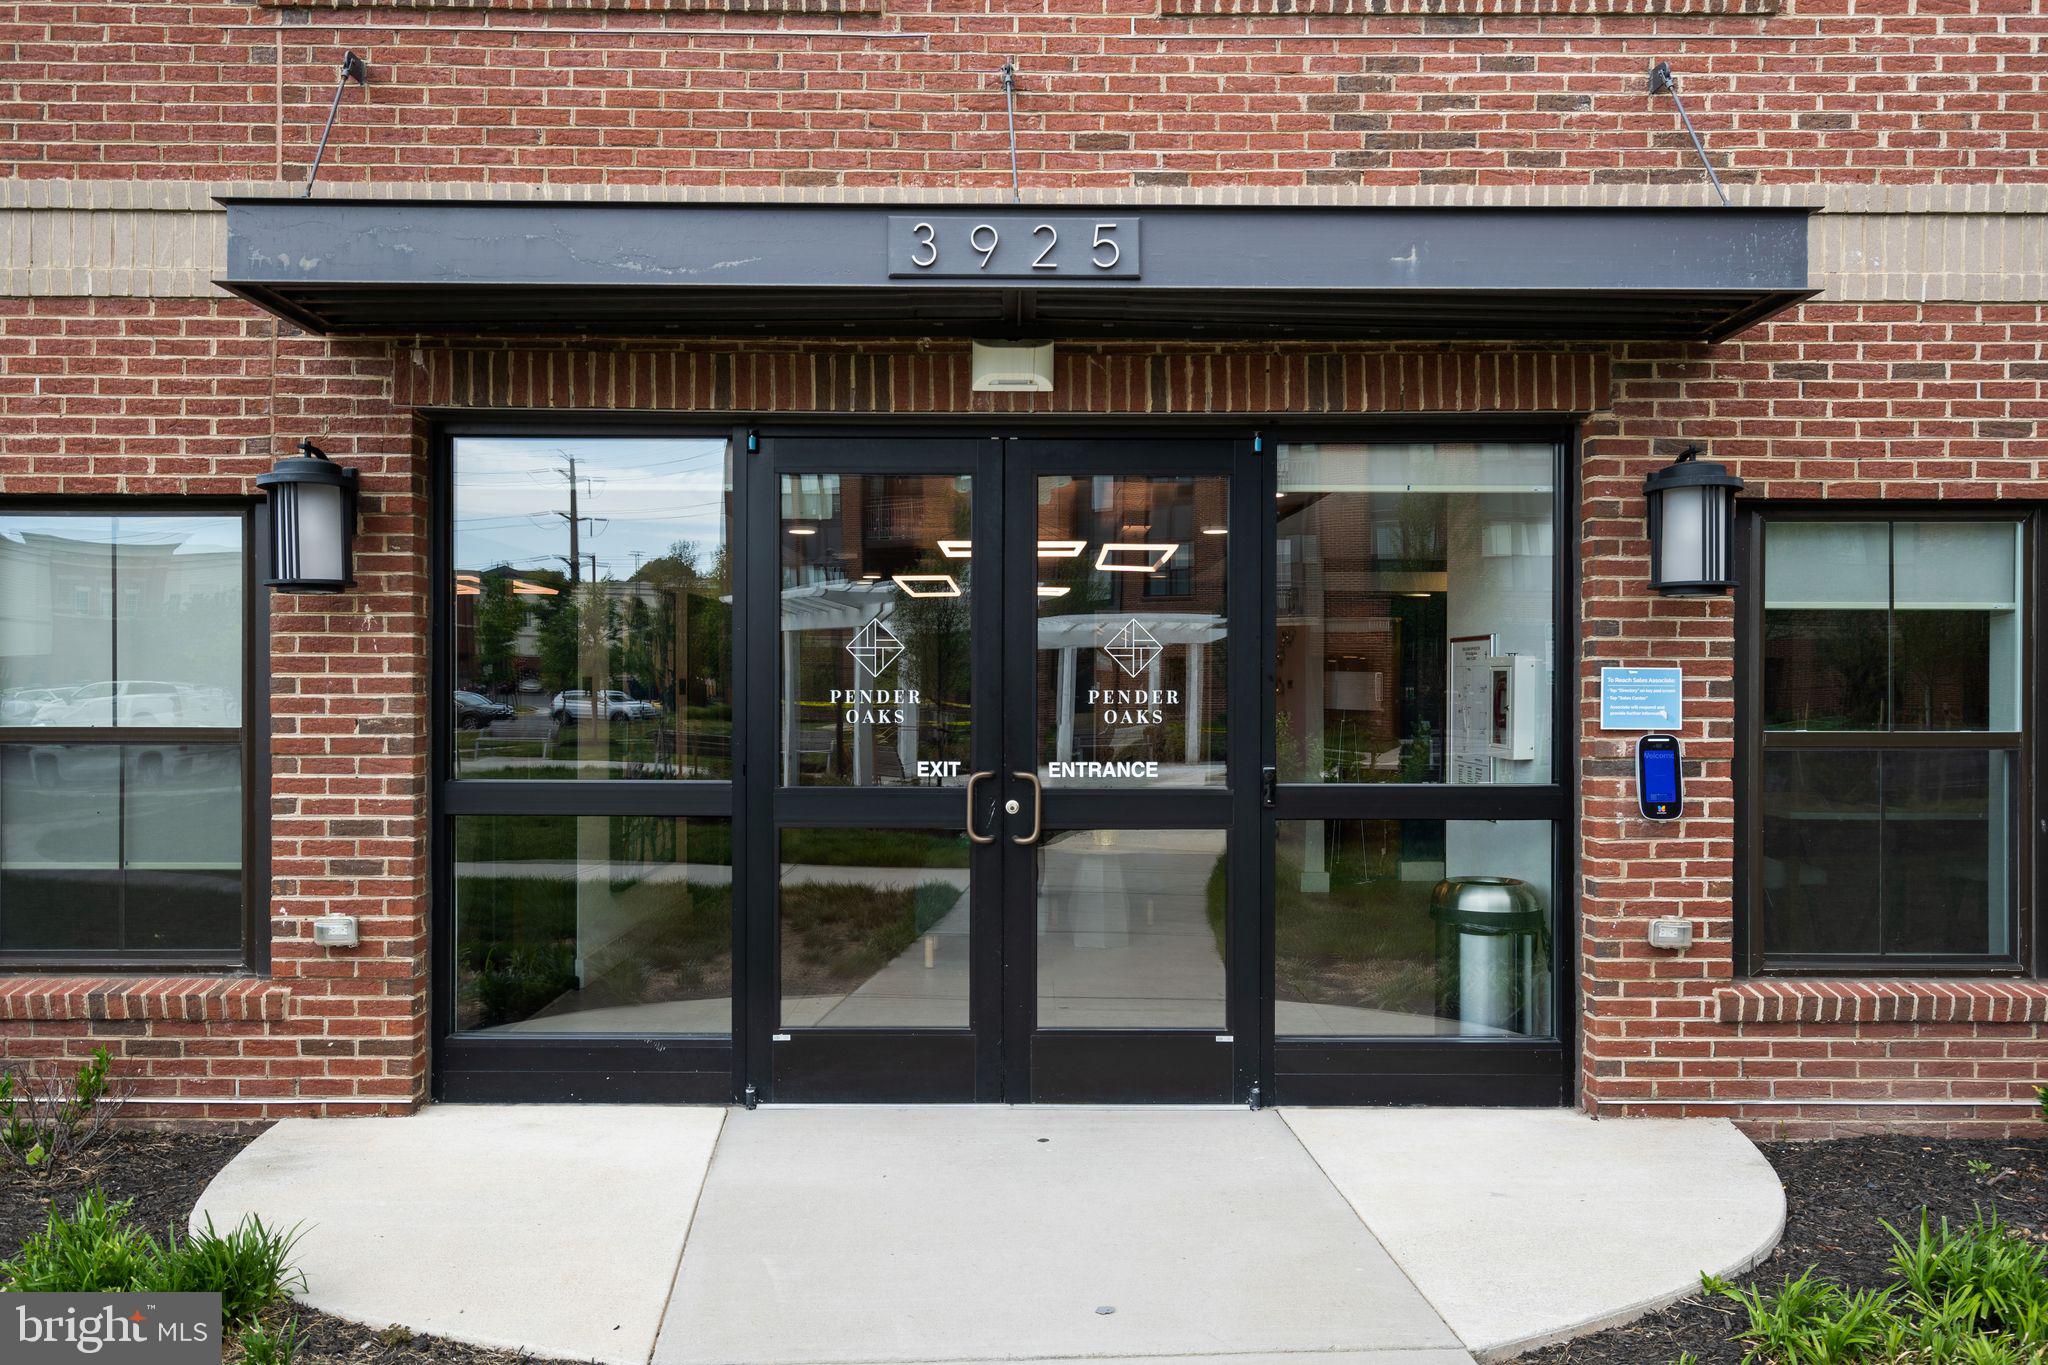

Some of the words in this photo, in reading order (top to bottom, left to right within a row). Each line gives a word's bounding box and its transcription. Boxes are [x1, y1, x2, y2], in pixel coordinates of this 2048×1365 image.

[830, 689, 921, 704] PENDER
[1087, 689, 1180, 704] PENDER
[845, 709, 905, 724] OAKS
[1103, 709, 1164, 724] OAKS
[916, 761, 961, 777] EXIT
[1048, 761, 1158, 778] ENTRANCE
